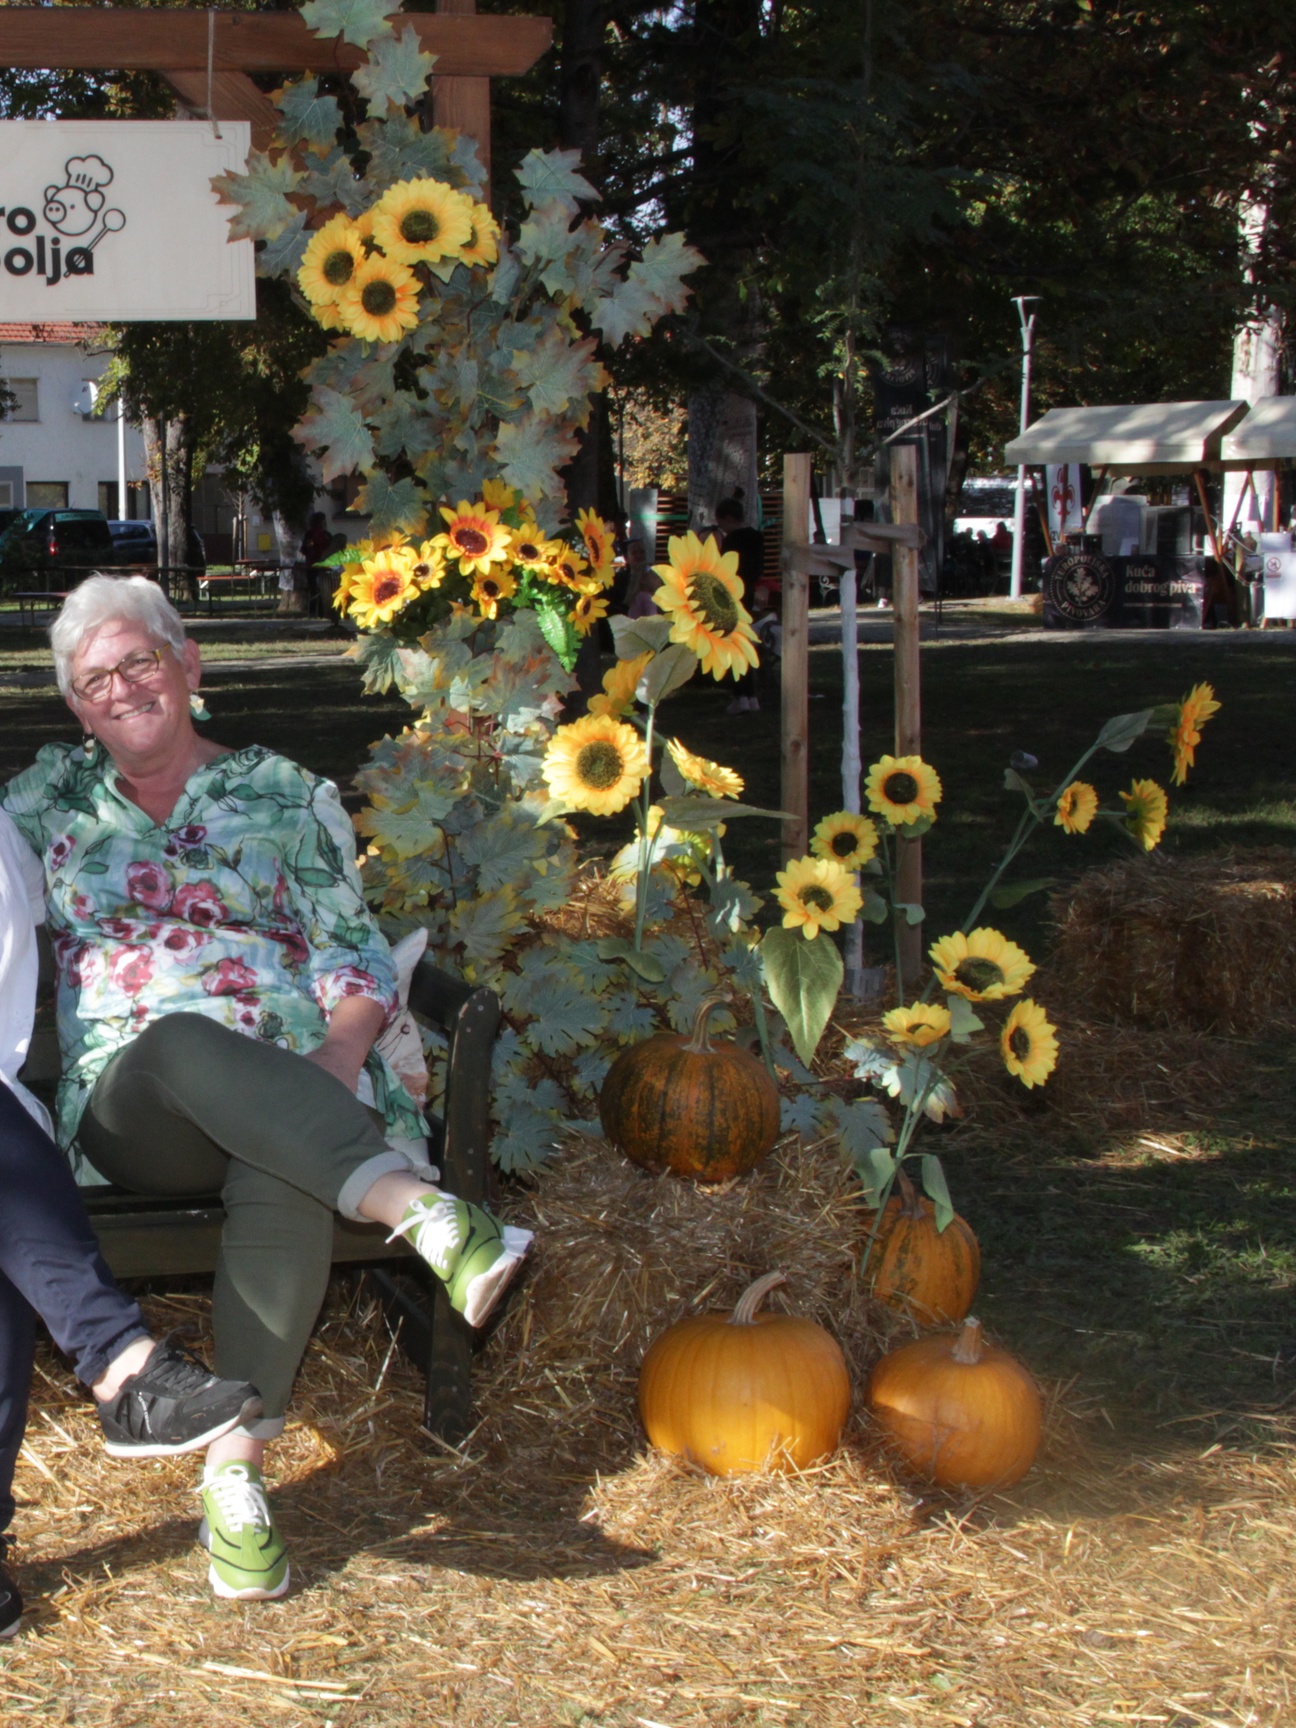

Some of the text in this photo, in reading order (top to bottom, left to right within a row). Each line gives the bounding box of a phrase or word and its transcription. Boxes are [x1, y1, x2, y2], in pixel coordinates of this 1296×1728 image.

[1126, 564, 1155, 578] Kuća
[1125, 580, 1197, 597] dobrog piva
